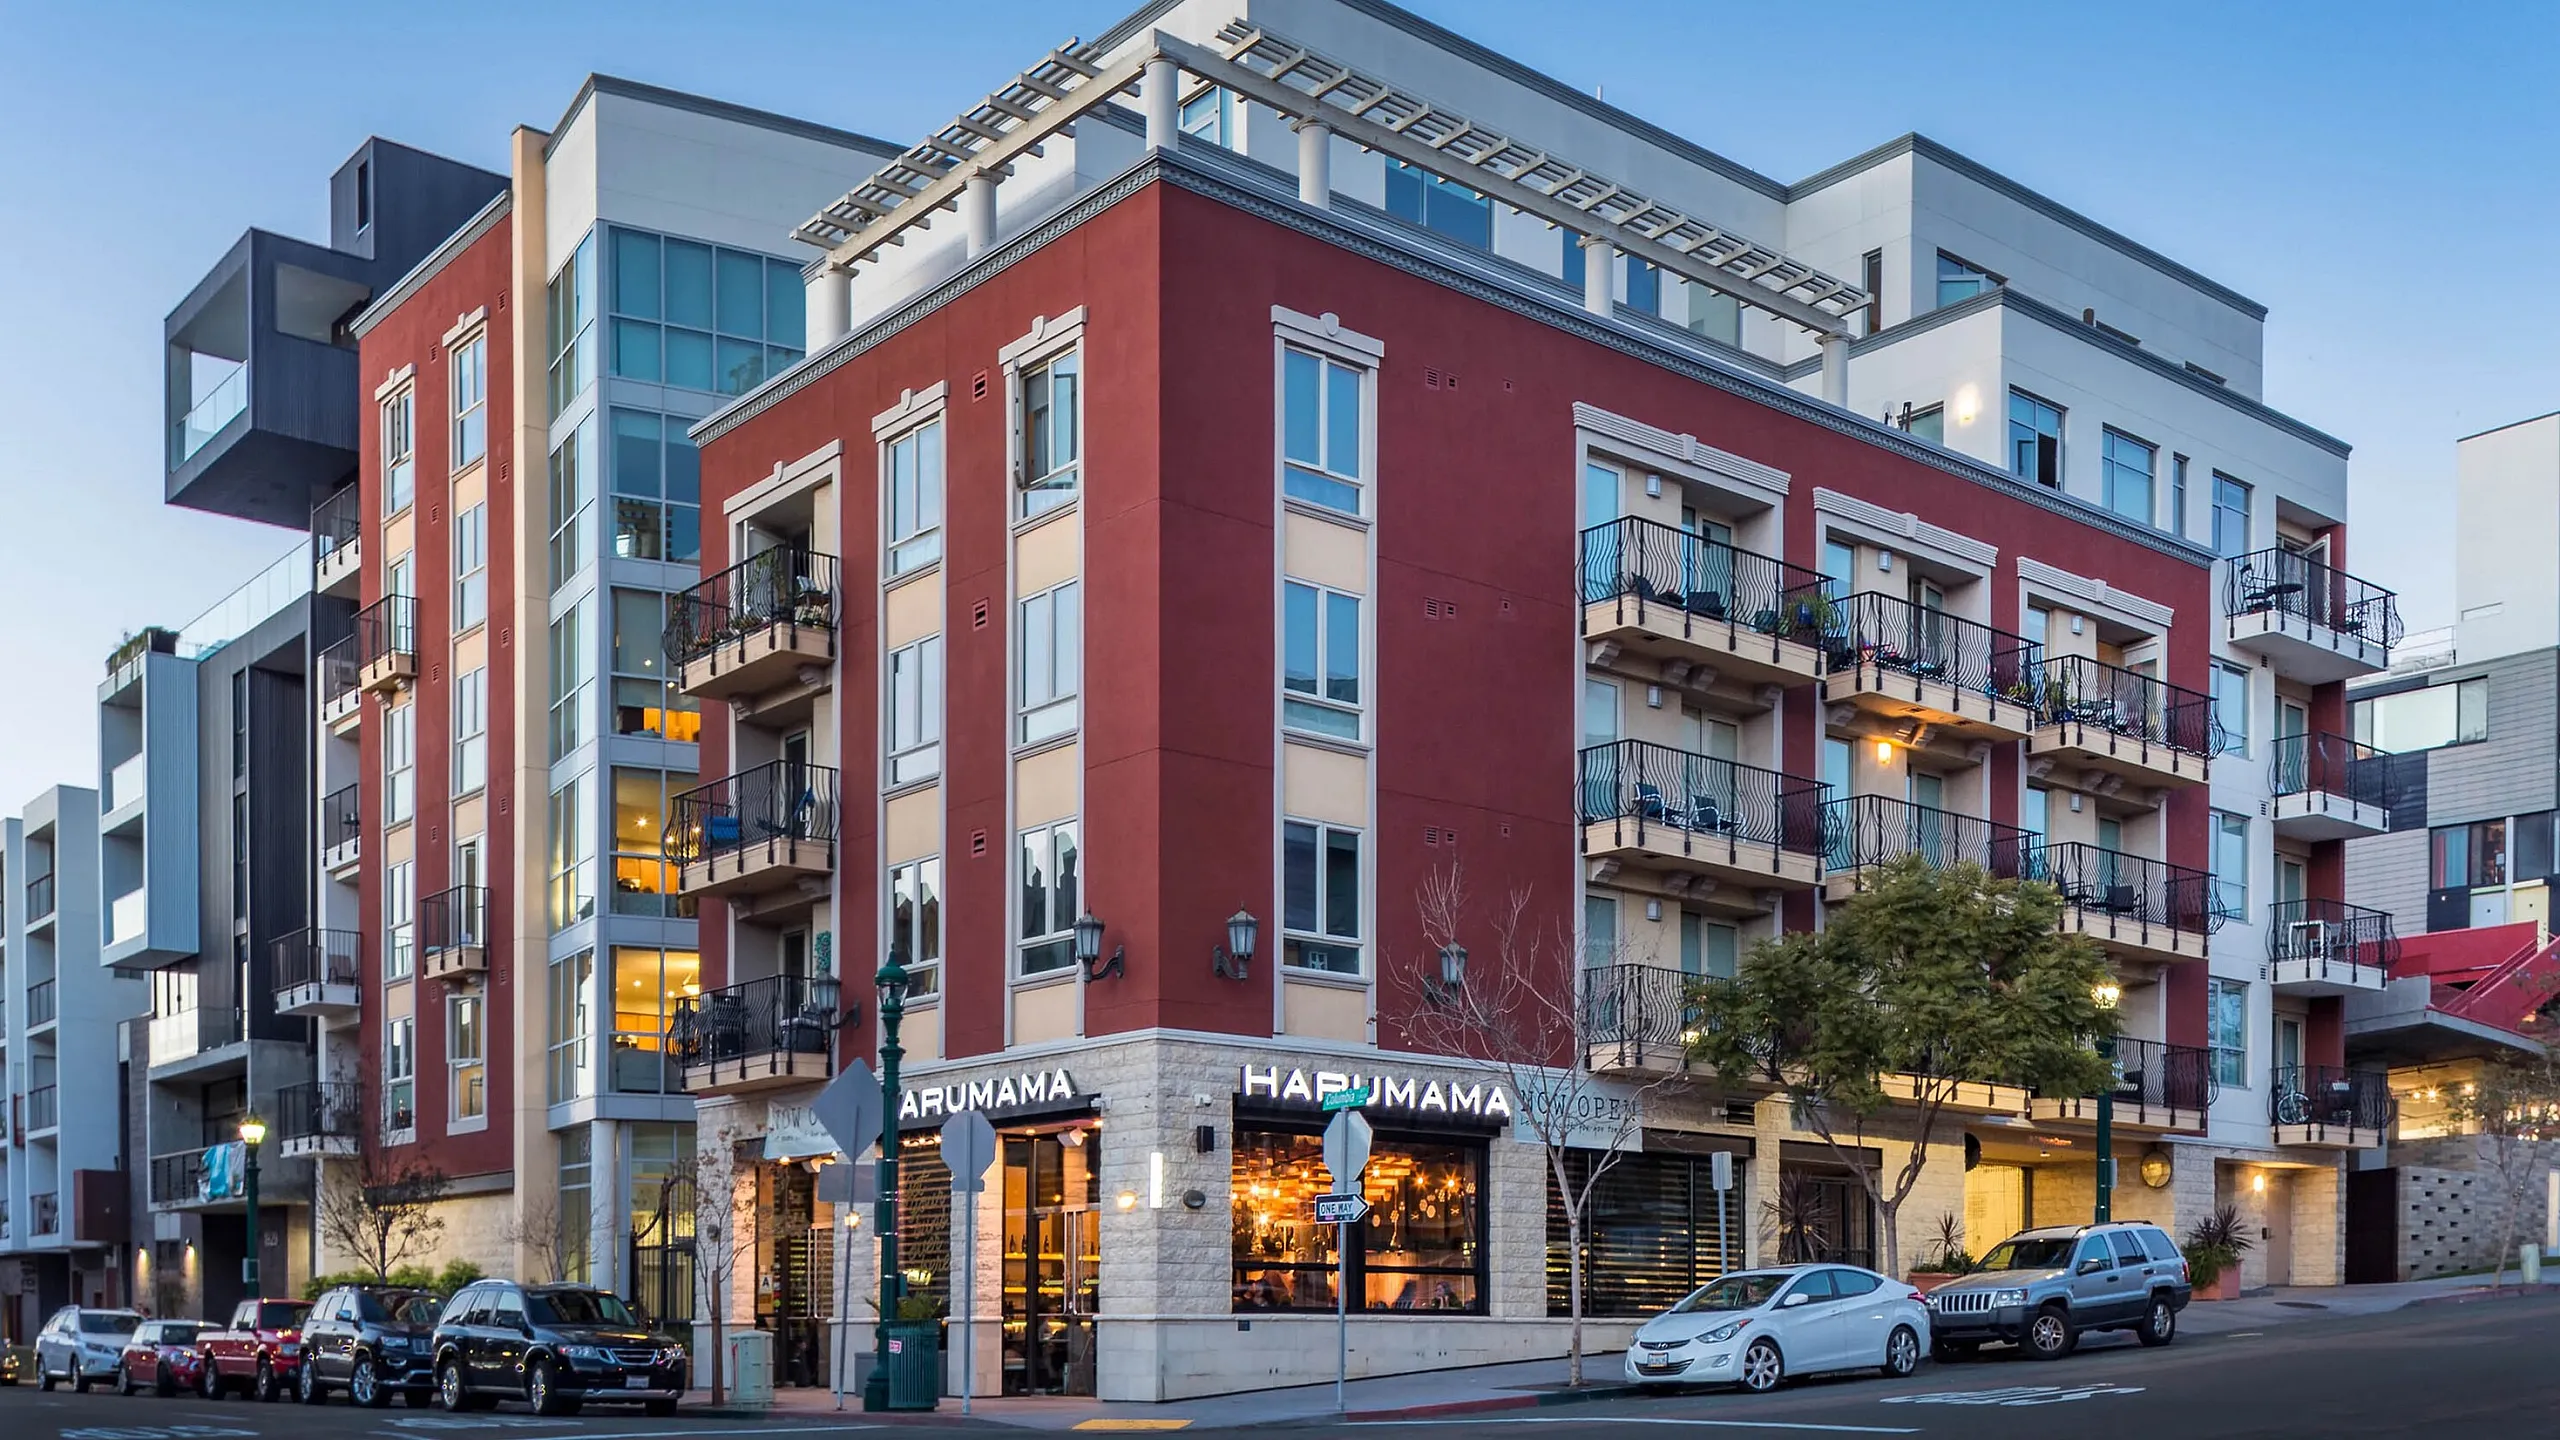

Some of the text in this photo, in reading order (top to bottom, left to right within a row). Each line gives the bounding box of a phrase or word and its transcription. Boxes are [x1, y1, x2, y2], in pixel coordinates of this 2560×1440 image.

[899, 1067, 1074, 1120] ARUMAMA
[1242, 1064, 1511, 1117] HARUMAMA
[1520, 1089, 1567, 1116] NOW
[1320, 1202, 1353, 1215] ONE WAY
[762, 1276, 770, 1287] A
